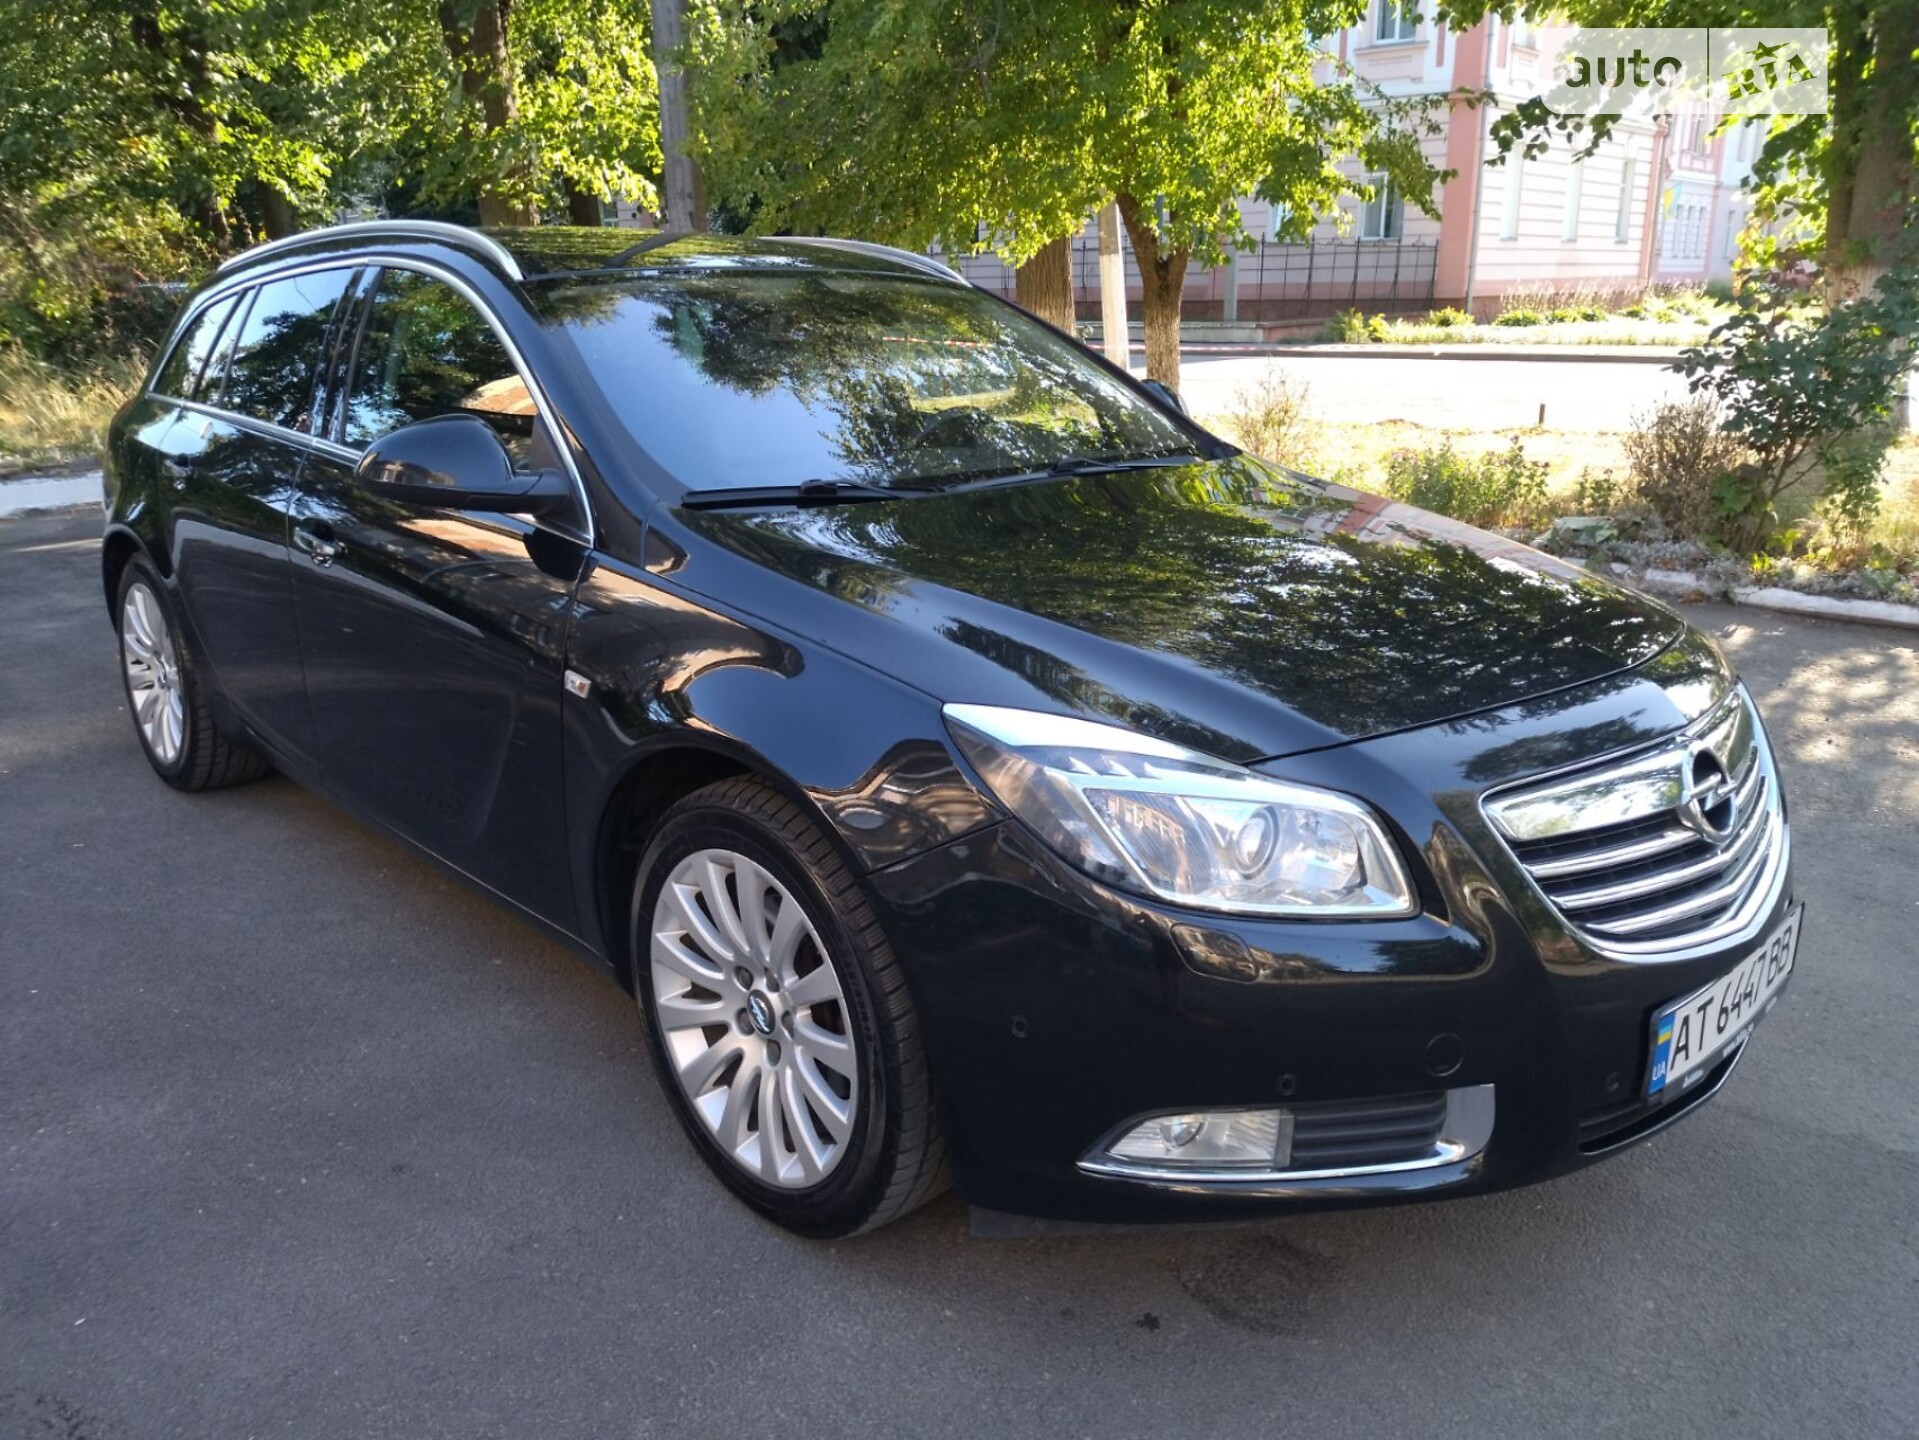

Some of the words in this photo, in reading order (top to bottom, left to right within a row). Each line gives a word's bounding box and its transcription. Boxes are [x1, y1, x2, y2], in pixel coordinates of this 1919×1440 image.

[1669, 996, 1714, 1071] AT
[1717, 950, 1767, 1034] 6447
[1766, 925, 1792, 988] BB
[1652, 1061, 1666, 1081] UA
